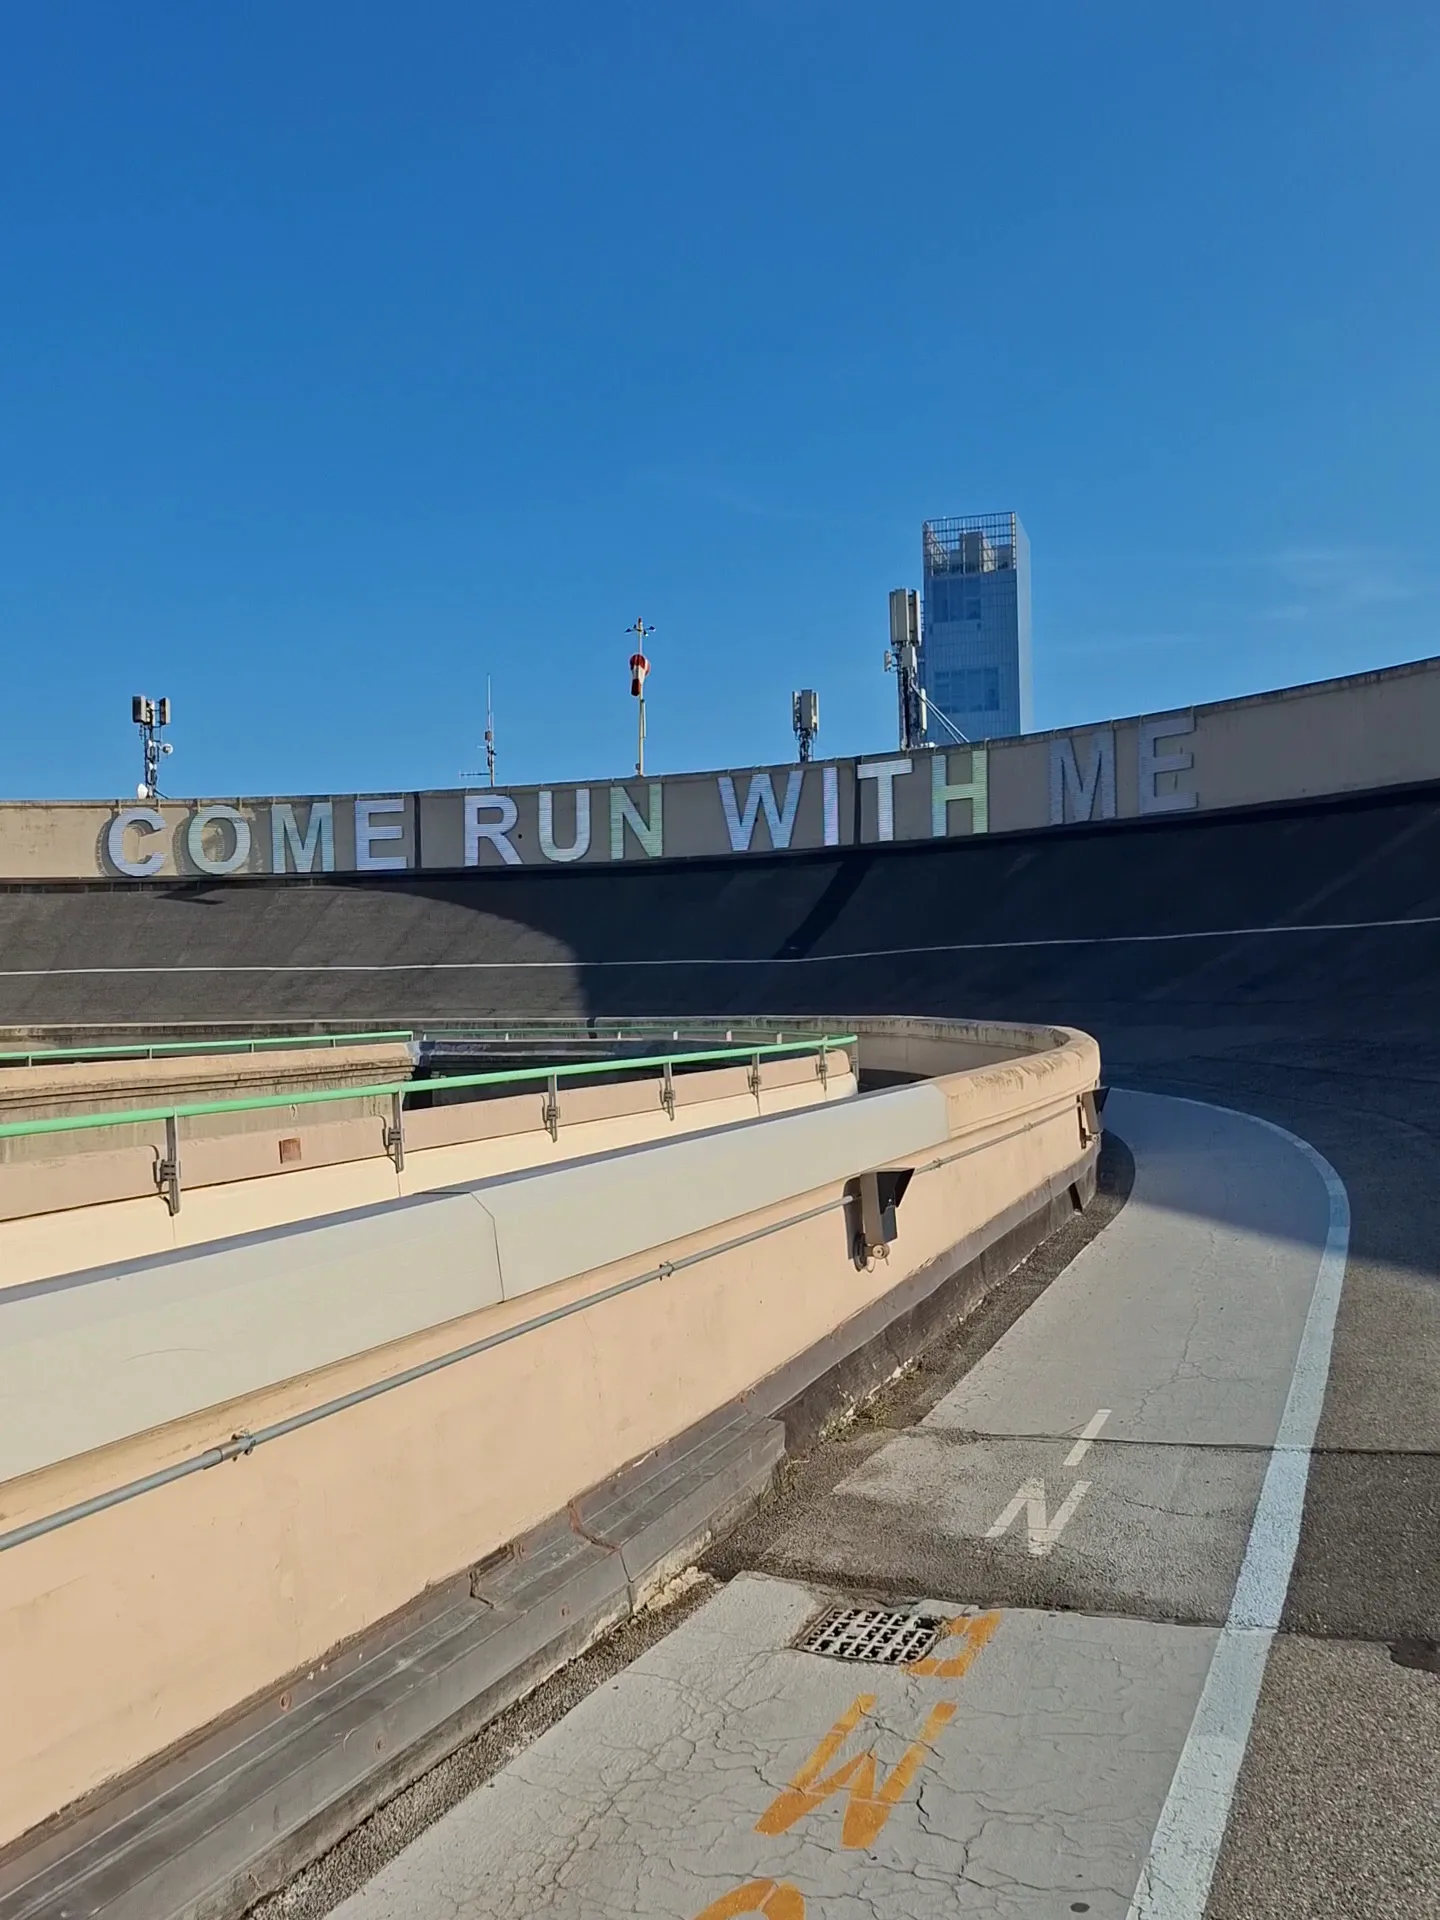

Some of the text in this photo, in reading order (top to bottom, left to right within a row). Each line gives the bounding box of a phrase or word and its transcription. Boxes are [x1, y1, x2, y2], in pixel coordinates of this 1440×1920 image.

[107, 716, 1198, 879] COME RUN WITH ME
